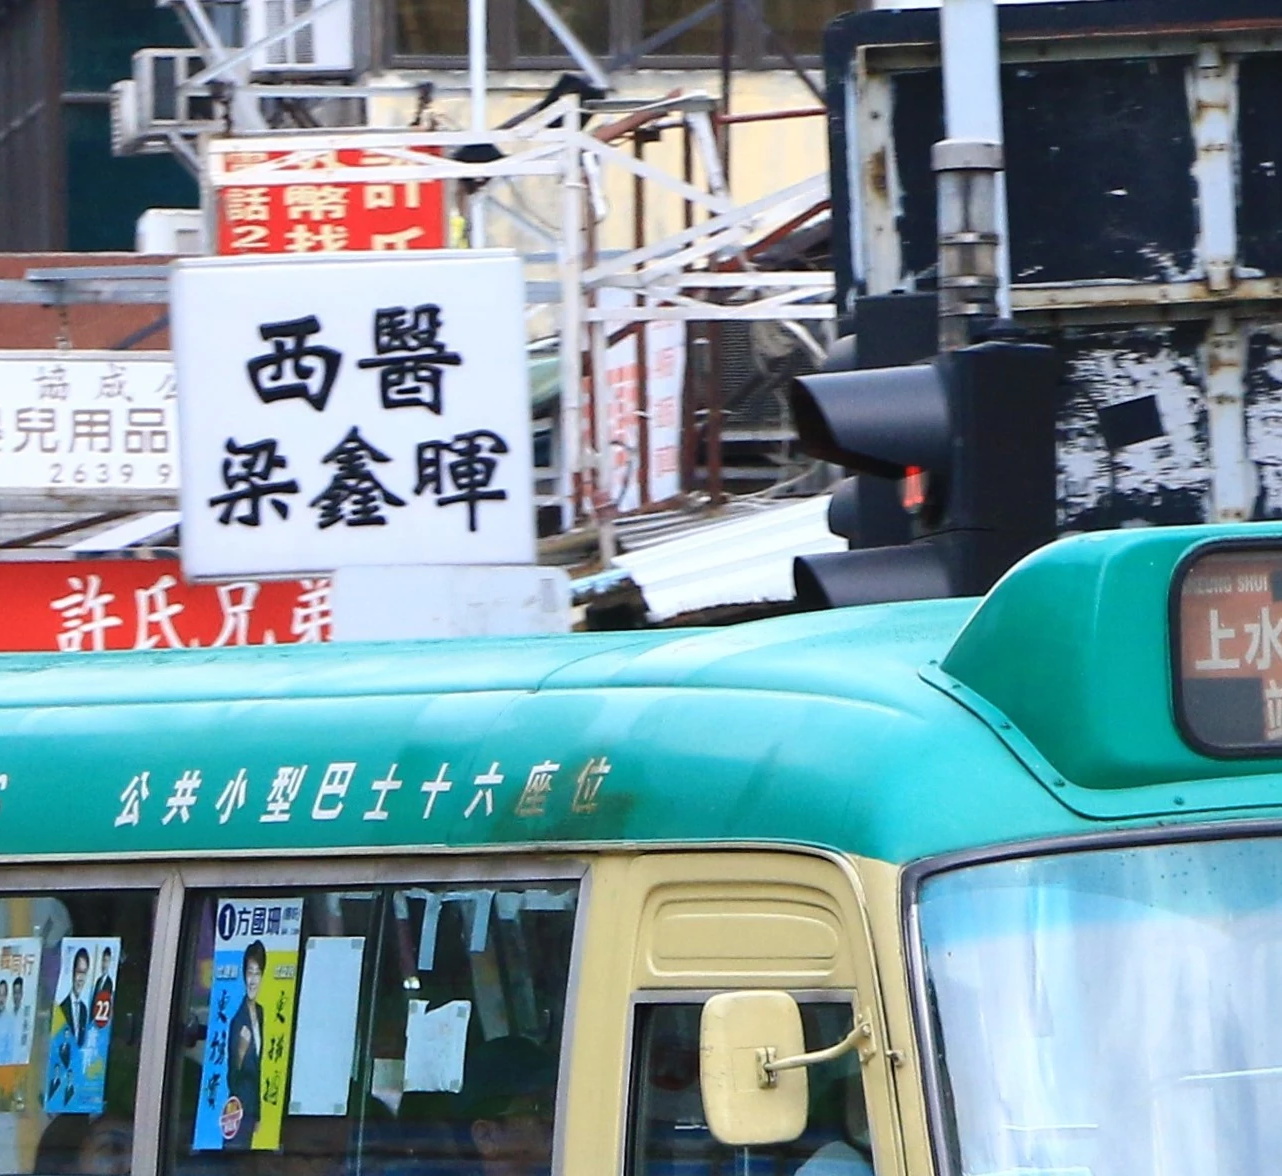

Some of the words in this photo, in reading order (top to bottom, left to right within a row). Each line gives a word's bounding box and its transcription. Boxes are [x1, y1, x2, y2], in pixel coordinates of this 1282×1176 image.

[246, 303, 462, 414] 西醫
[50, 463, 134, 484] 2639
[1237, 575, 1268, 593] SHUI
[114, 756, 612, 828] 公共小型巴士十六座位
[94, 1000, 110, 1021] 22
